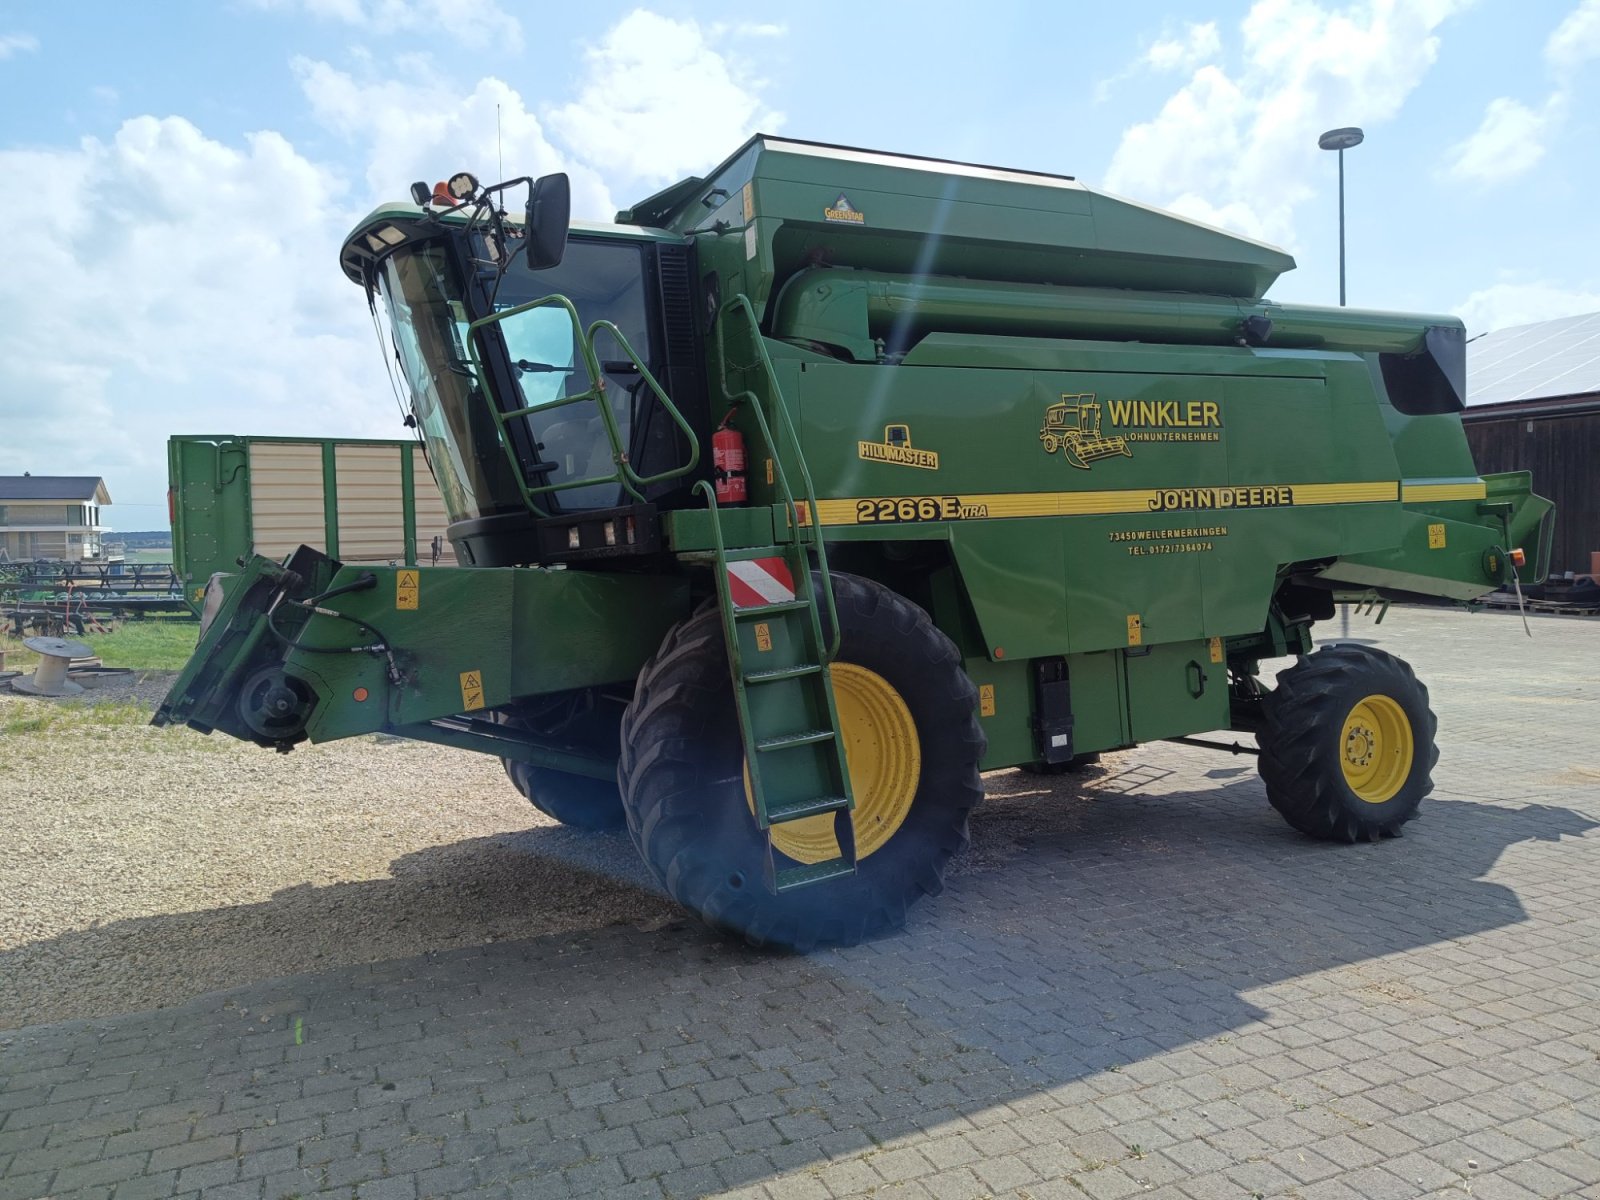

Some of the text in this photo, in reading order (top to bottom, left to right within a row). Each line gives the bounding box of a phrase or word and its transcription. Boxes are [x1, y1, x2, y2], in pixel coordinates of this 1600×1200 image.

[1107, 400, 1222, 427] WINKLER
[1124, 432, 1220, 442] LOHNUNTERNEHMEN
[860, 442, 936, 468] HILL MASTER
[857, 498, 940, 522] 2266
[1149, 486, 1293, 511] JOHN DEERE
